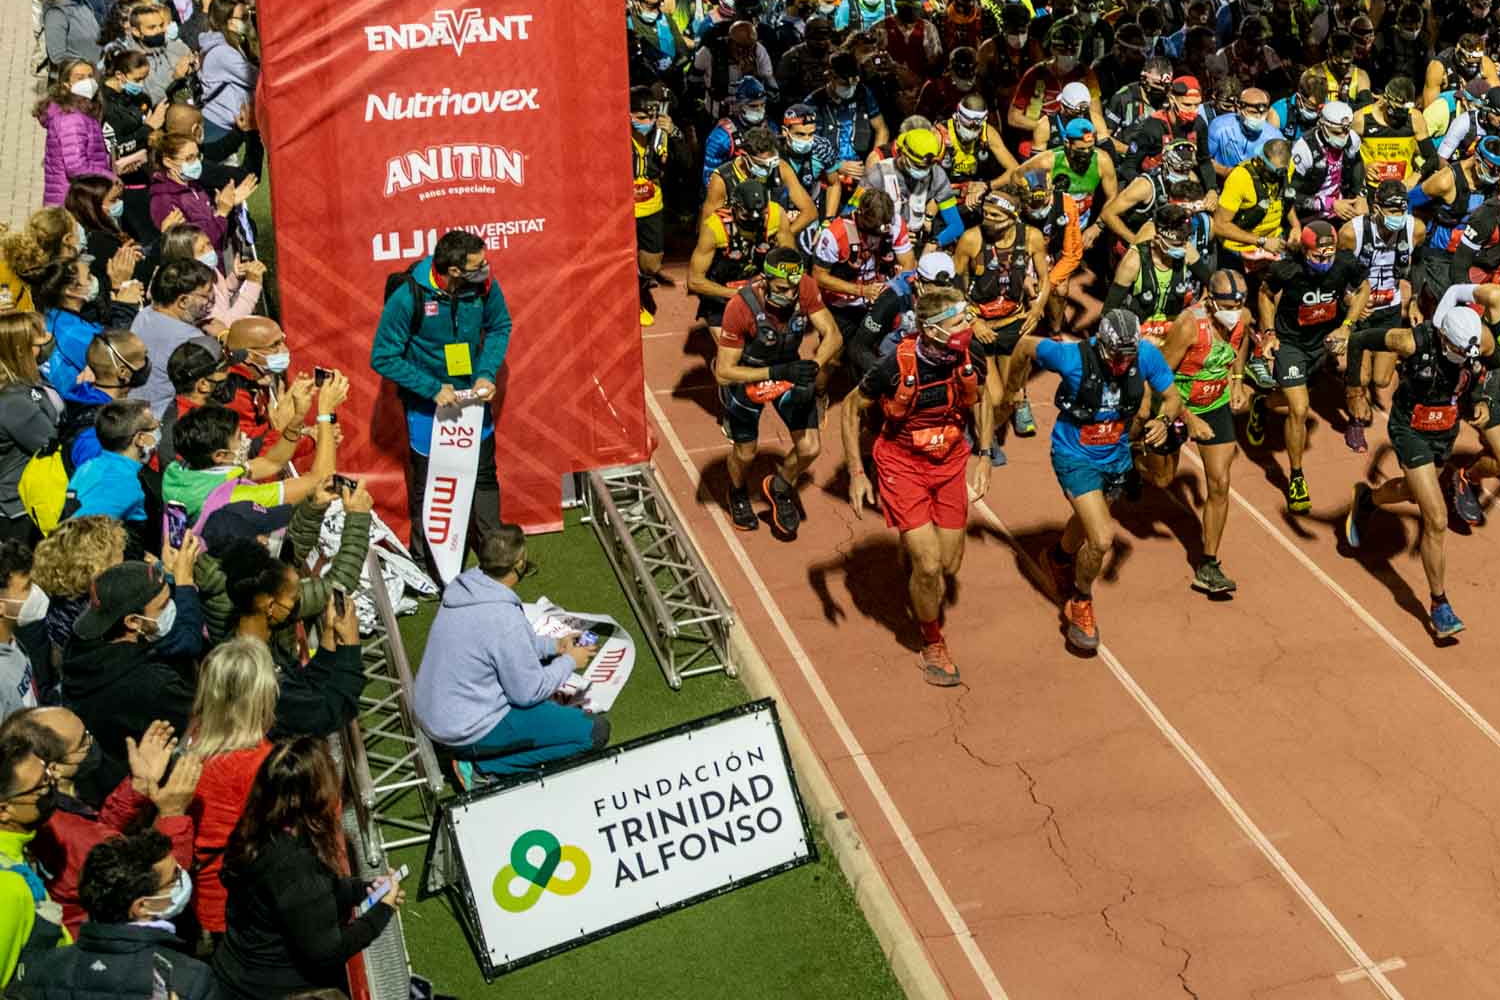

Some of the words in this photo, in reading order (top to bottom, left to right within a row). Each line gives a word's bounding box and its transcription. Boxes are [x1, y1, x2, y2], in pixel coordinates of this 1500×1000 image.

[364, 7, 533, 57] ENDAVANT
[364, 87, 540, 121] Nutrinovex
[384, 144, 526, 197] ANITIN
[418, 188, 446, 201] panes
[448, 185, 496, 196] especiales
[445, 218, 546, 236] IVERSITAT
[440, 427, 456, 448] 21
[456, 427, 474, 449] 20
[929, 434, 944, 445] 41
[1099, 423, 1112, 433] 31
[594, 745, 765, 817] FUNDACIÓN
[600, 773, 775, 854] TRINIDAD
[615, 806, 783, 888] ALFONSO
